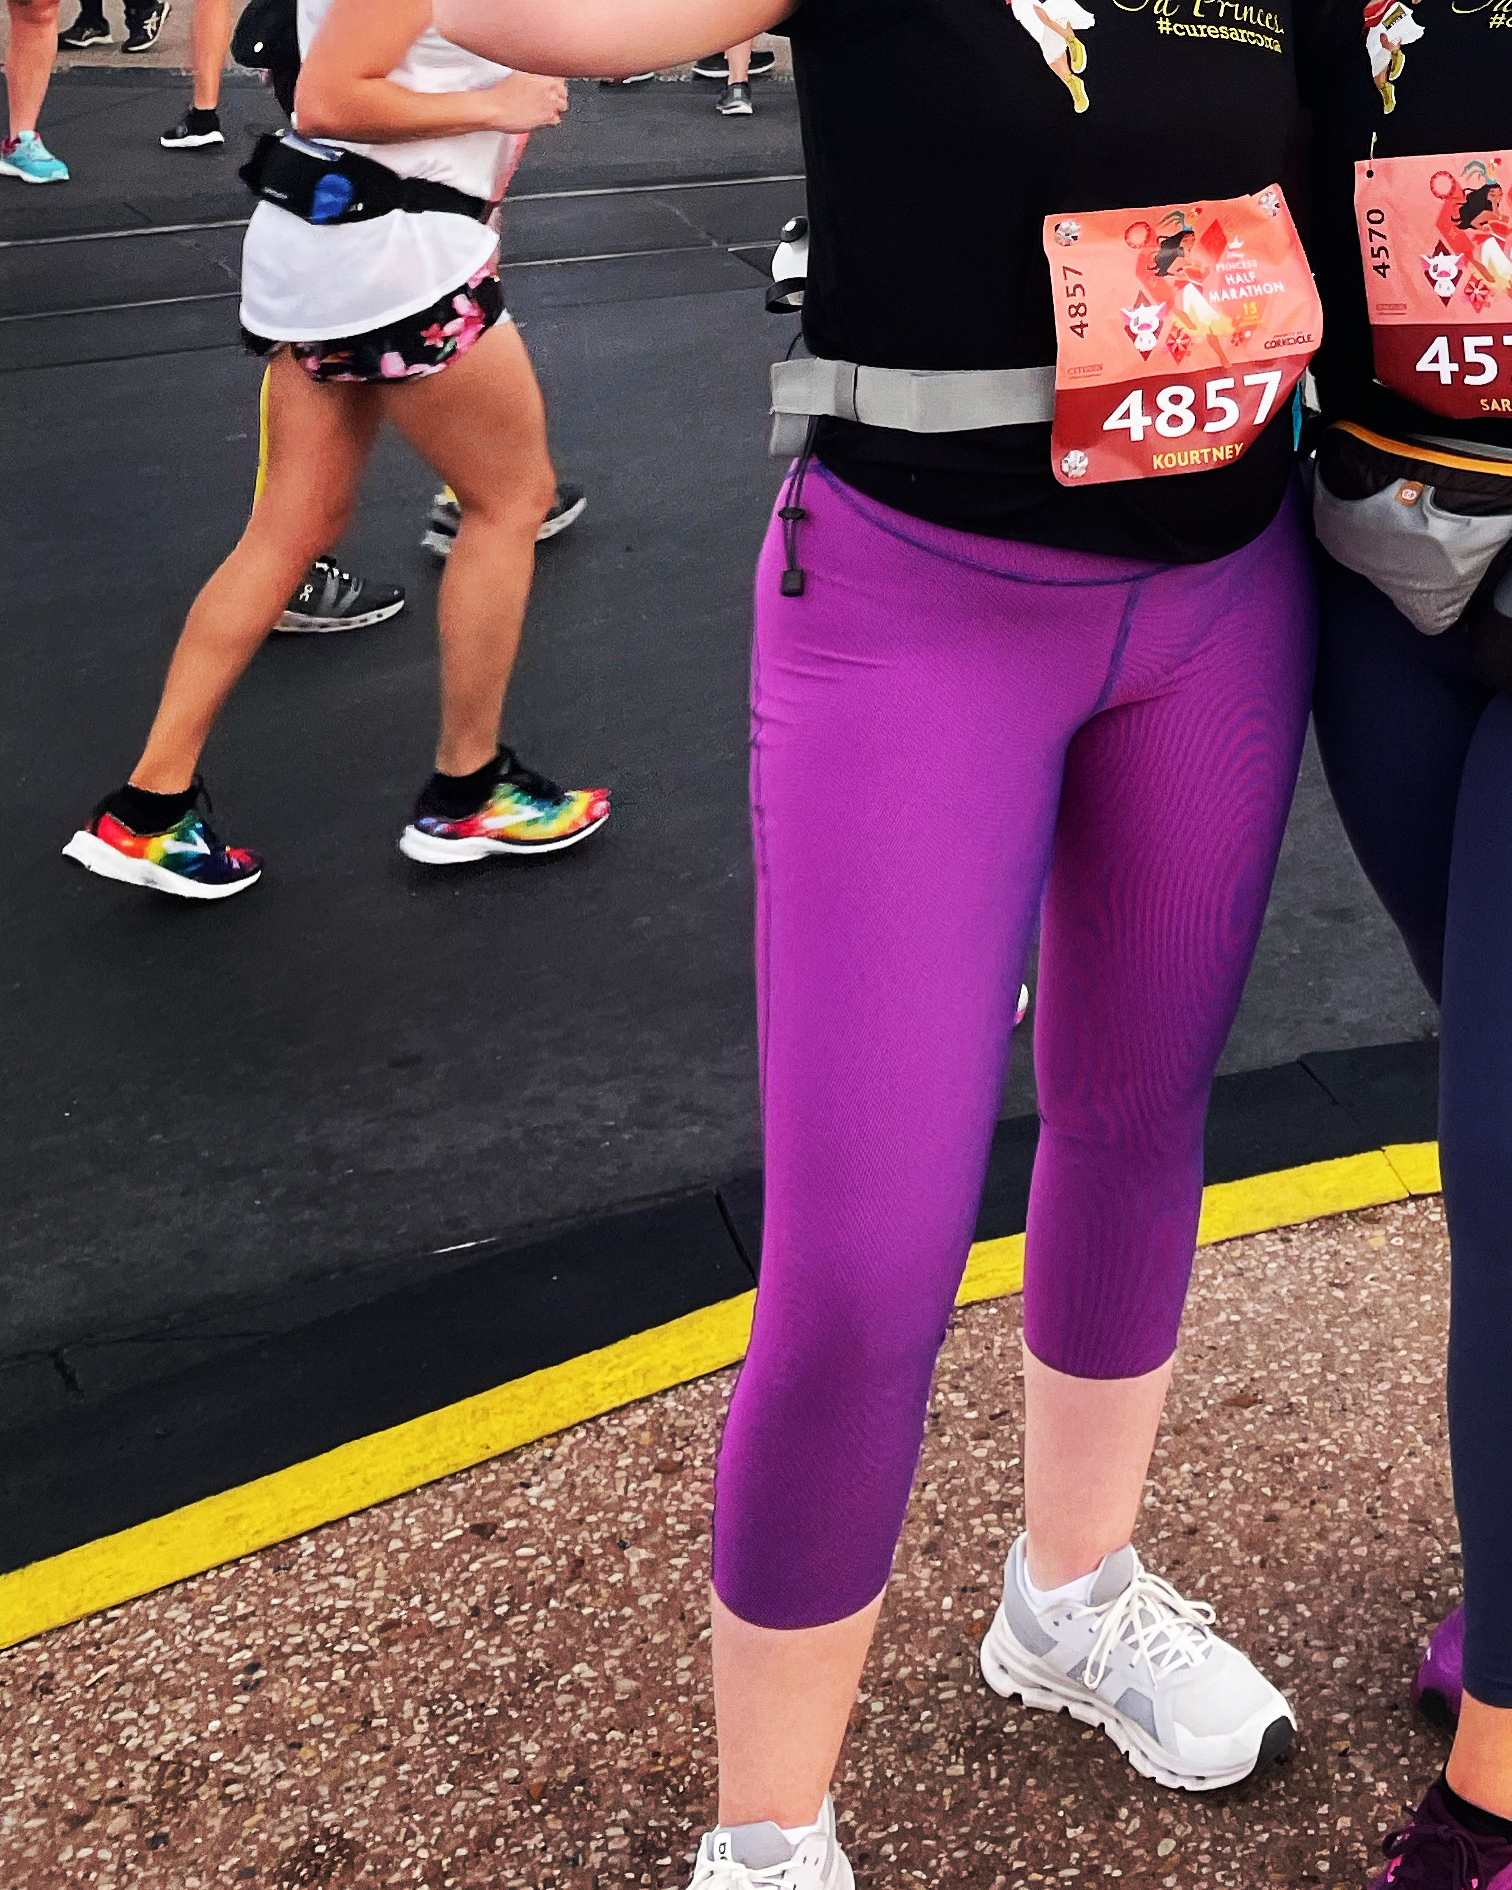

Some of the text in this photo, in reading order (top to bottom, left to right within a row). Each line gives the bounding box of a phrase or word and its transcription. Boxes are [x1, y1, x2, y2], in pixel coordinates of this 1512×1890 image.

[1366, 208, 1391, 279] 4570
[1215, 259, 1258, 272] PRINCESS
[1224, 271, 1256, 286] HALF
[1062, 265, 1090, 339] 4857
[1208, 281, 1285, 303] MARATHON
[1242, 301, 1258, 316] 15
[1102, 370, 1283, 442] 4857
[1152, 442, 1244, 470] KOURTNEY
